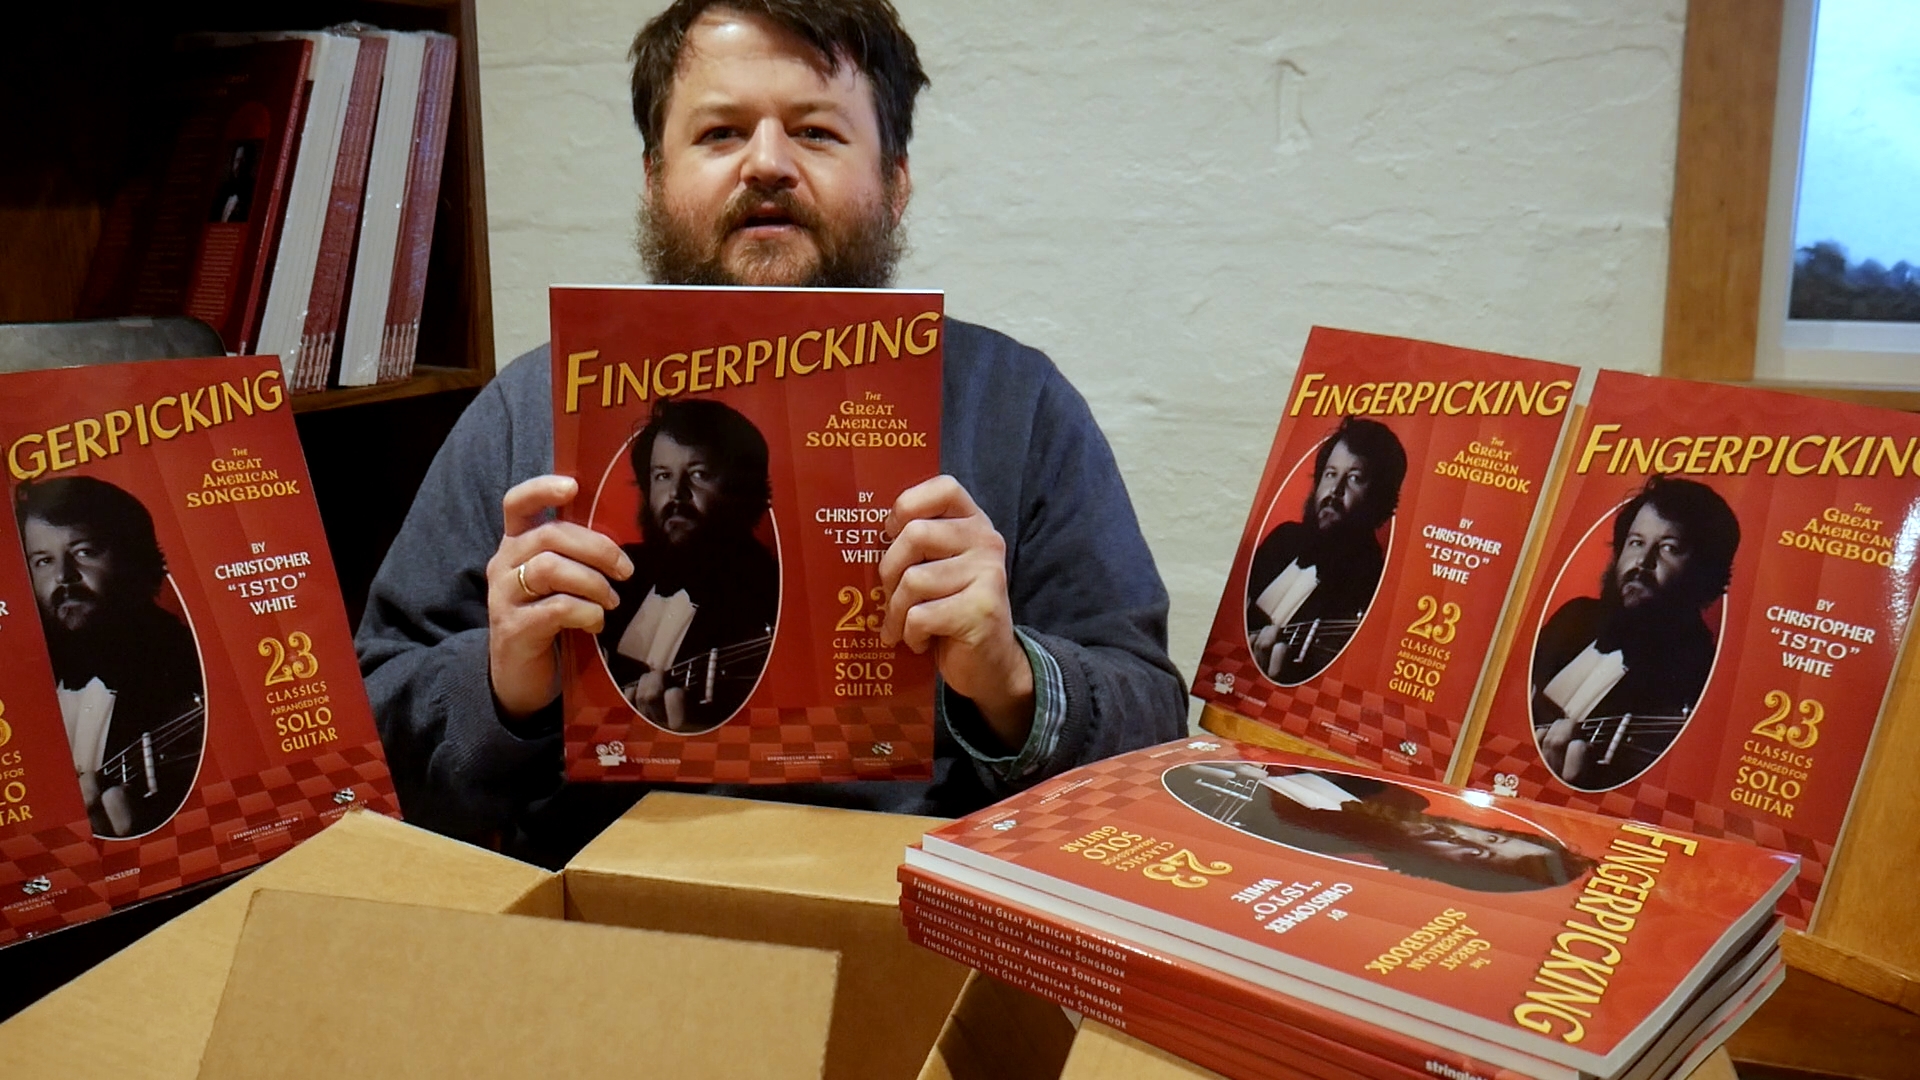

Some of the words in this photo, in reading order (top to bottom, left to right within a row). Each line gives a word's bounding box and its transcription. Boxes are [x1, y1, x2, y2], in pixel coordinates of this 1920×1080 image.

[565, 312, 941, 414] FINGERPICKING
[840, 401, 894, 415] GREAT
[865, 391, 881, 401] THE
[1289, 373, 1572, 417] FINGERPICKING
[8, 370, 283, 480] GERPICKING
[825, 415, 907, 430] AMERICAN
[232, 447, 247, 456] THE
[806, 431, 927, 447] SONGBOOK
[1468, 440, 1512, 460] GREAT
[1491, 437, 1504, 447] THE
[211, 457, 262, 473] GREAT
[1454, 449, 1519, 475] AMERICAN
[202, 470, 278, 488] AMERICAN
[1434, 461, 1531, 494] SONGBOOK
[187, 480, 300, 507] SONGBOOK
[858, 491, 874, 503] BY
[815, 508, 892, 523] CHRISTOP
[1823, 507, 1883, 532] GREAT
[1853, 502, 1873, 514] THE
[1459, 517, 1473, 530] BY
[1803, 518, 1894, 549] AMERICAN
[251, 542, 265, 554] BY
[1423, 524, 1502, 556] CHRISTOPHER
[1778, 530, 1895, 567] SONGBOO
[215, 551, 310, 580] CHRISTOPHER
[842, 549, 888, 564] WHIT
[1425, 542, 1490, 569] “ISTO”
[228, 572, 306, 599] “ISTO”
[1432, 563, 1469, 586] WHITE
[250, 595, 296, 615] WHITE
[1816, 598, 1835, 613] BY
[1406, 594, 1461, 645] 23
[1766, 605, 1876, 645] CHRISTOPHER
[833, 652, 877, 660] ARRANGED
[879, 651, 896, 660] FOR
[1400, 637, 1451, 662] CLASSICS
[1771, 627, 1860, 660] “ISTO”
[258, 630, 319, 686] 23
[834, 662, 893, 681] SOLO
[1397, 651, 1431, 667] ARRANGED
[1432, 660, 1447, 671] FOR
[1782, 651, 1834, 678] WHITE
[1394, 660, 1441, 687] SOLO
[266, 681, 327, 703] CLASSICS
[834, 682, 893, 696] GUITAR
[1389, 678, 1435, 703] GUITAR
[271, 699, 313, 716] ARRANGED
[313, 695, 330, 706] FOR
[275, 707, 331, 735] SOLO
[1751, 689, 1825, 750] 23
[281, 727, 337, 752] GUITAR
[1740, 755, 1788, 775] ARRANGED
[1788, 768, 1808, 781] FOR
[1744, 740, 1814, 769] CLASSICS
[1735, 765, 1801, 800] SOLO
[1730, 787, 1795, 819] GUITAR
[1059, 825, 1118, 853] GUITAR
[1083, 831, 1142, 860] SOLO
[1115, 841, 1174, 872] CLASSICS
[1142, 848, 1233, 888] 23
[1231, 878, 1283, 904] WHITE
[1254, 881, 1322, 921] “ISTO”
[913, 876, 975, 908] FINGERPICKING
[977, 902, 993, 914] THE
[995, 907, 1023, 924] GREAT
[1025, 918, 1072, 942] AMERICAN
[1075, 935, 1128, 962] SONGBOOK
[1264, 882, 1353, 934] CHRISTOPHER
[1327, 908, 1348, 921] BY
[917, 890, 977, 922] FINGERPICKING
[980, 917, 995, 928] THE
[997, 921, 1024, 939] GREAT
[1027, 932, 1072, 958] AMERICAN
[1075, 950, 1126, 978] SONGBOOK
[1365, 908, 1467, 975] SONGBOOK
[1512, 822, 1698, 1044] FINGERPICKING
[915, 906, 974, 936] FINGERPICKING
[977, 931, 992, 943] THE
[994, 937, 1021, 953] GREAT
[1024, 948, 1069, 974] AMERICAN
[1071, 966, 1122, 995] SONGBOOK
[1406, 924, 1479, 971] AMERICAN
[1439, 938, 1491, 971] GREAT
[918, 922, 977, 953] FINGERPICKING
[980, 947, 995, 960] THE
[997, 954, 1024, 971] GREAT
[1026, 965, 1071, 992] AMERICAN
[1073, 984, 1124, 1013] SONGBOOK
[923, 936, 982, 968] FINGERPICKING
[984, 963, 999, 976] THE
[1001, 970, 1028, 988] GREAT
[1030, 981, 1075, 1008] AMERICAN
[1077, 1000, 1128, 1030] SONGBOOK
